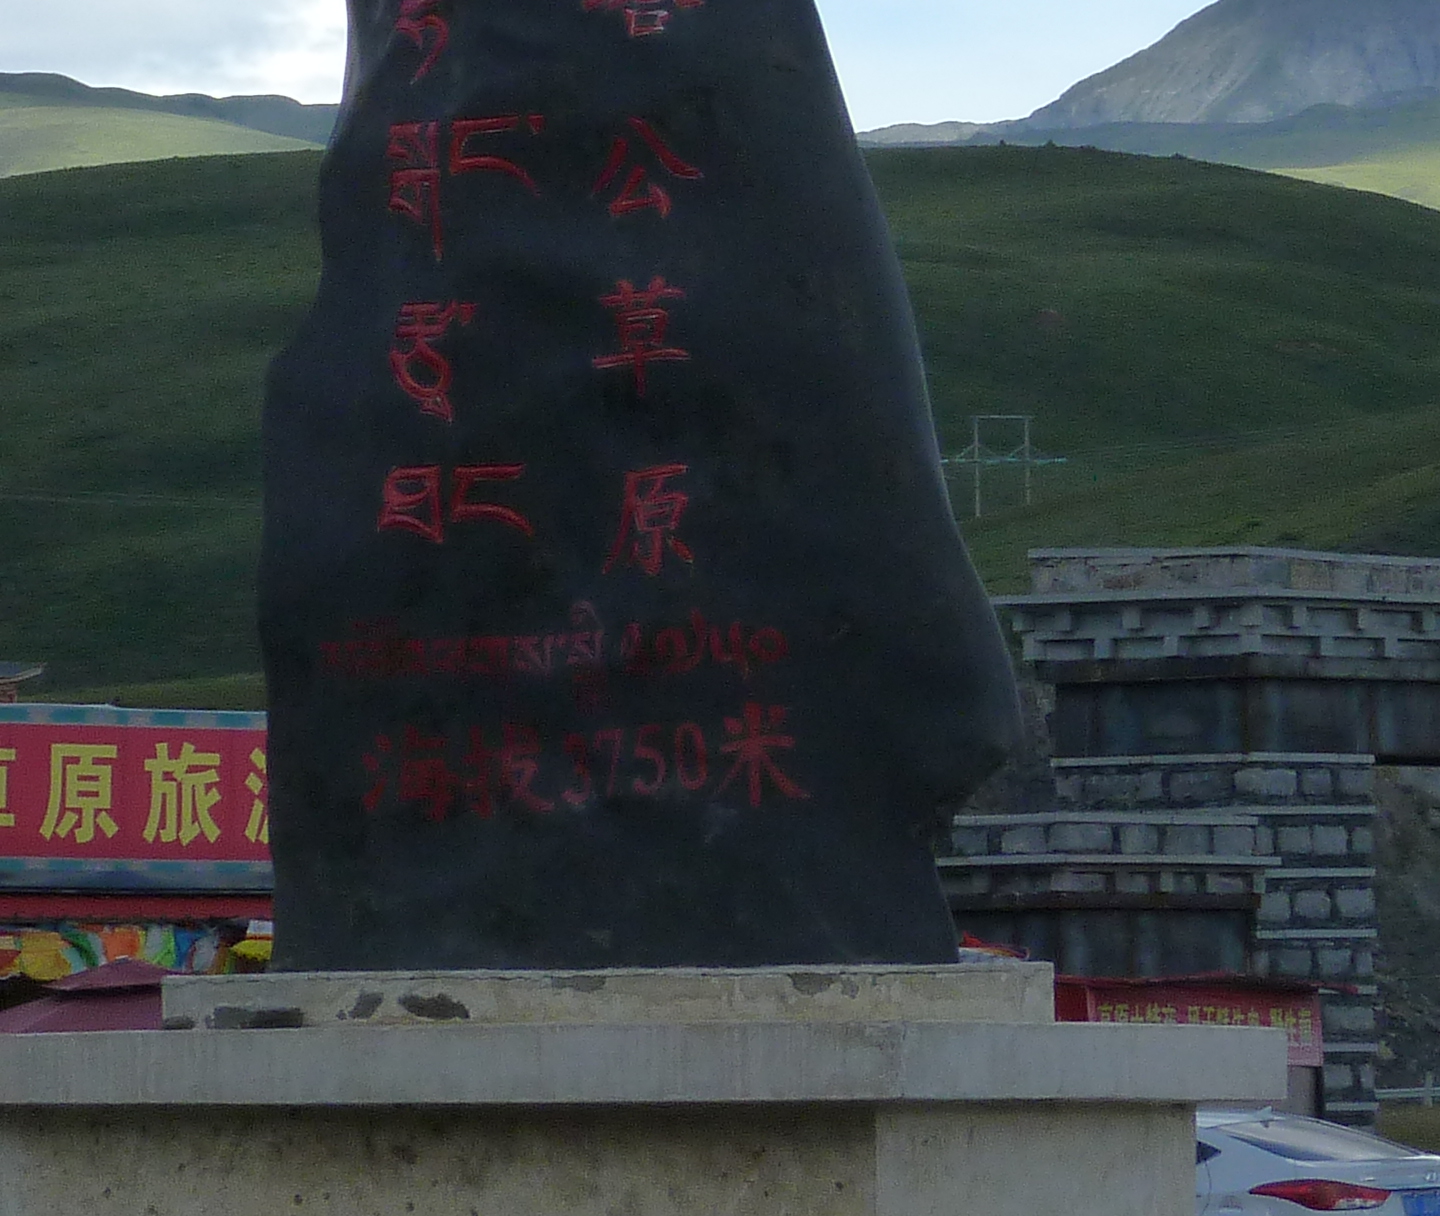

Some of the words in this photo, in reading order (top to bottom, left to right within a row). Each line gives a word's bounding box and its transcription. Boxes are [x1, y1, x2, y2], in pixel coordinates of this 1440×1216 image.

[0, 741, 270, 846] 原旅
[361, 699, 809, 824] 海拔3750米
